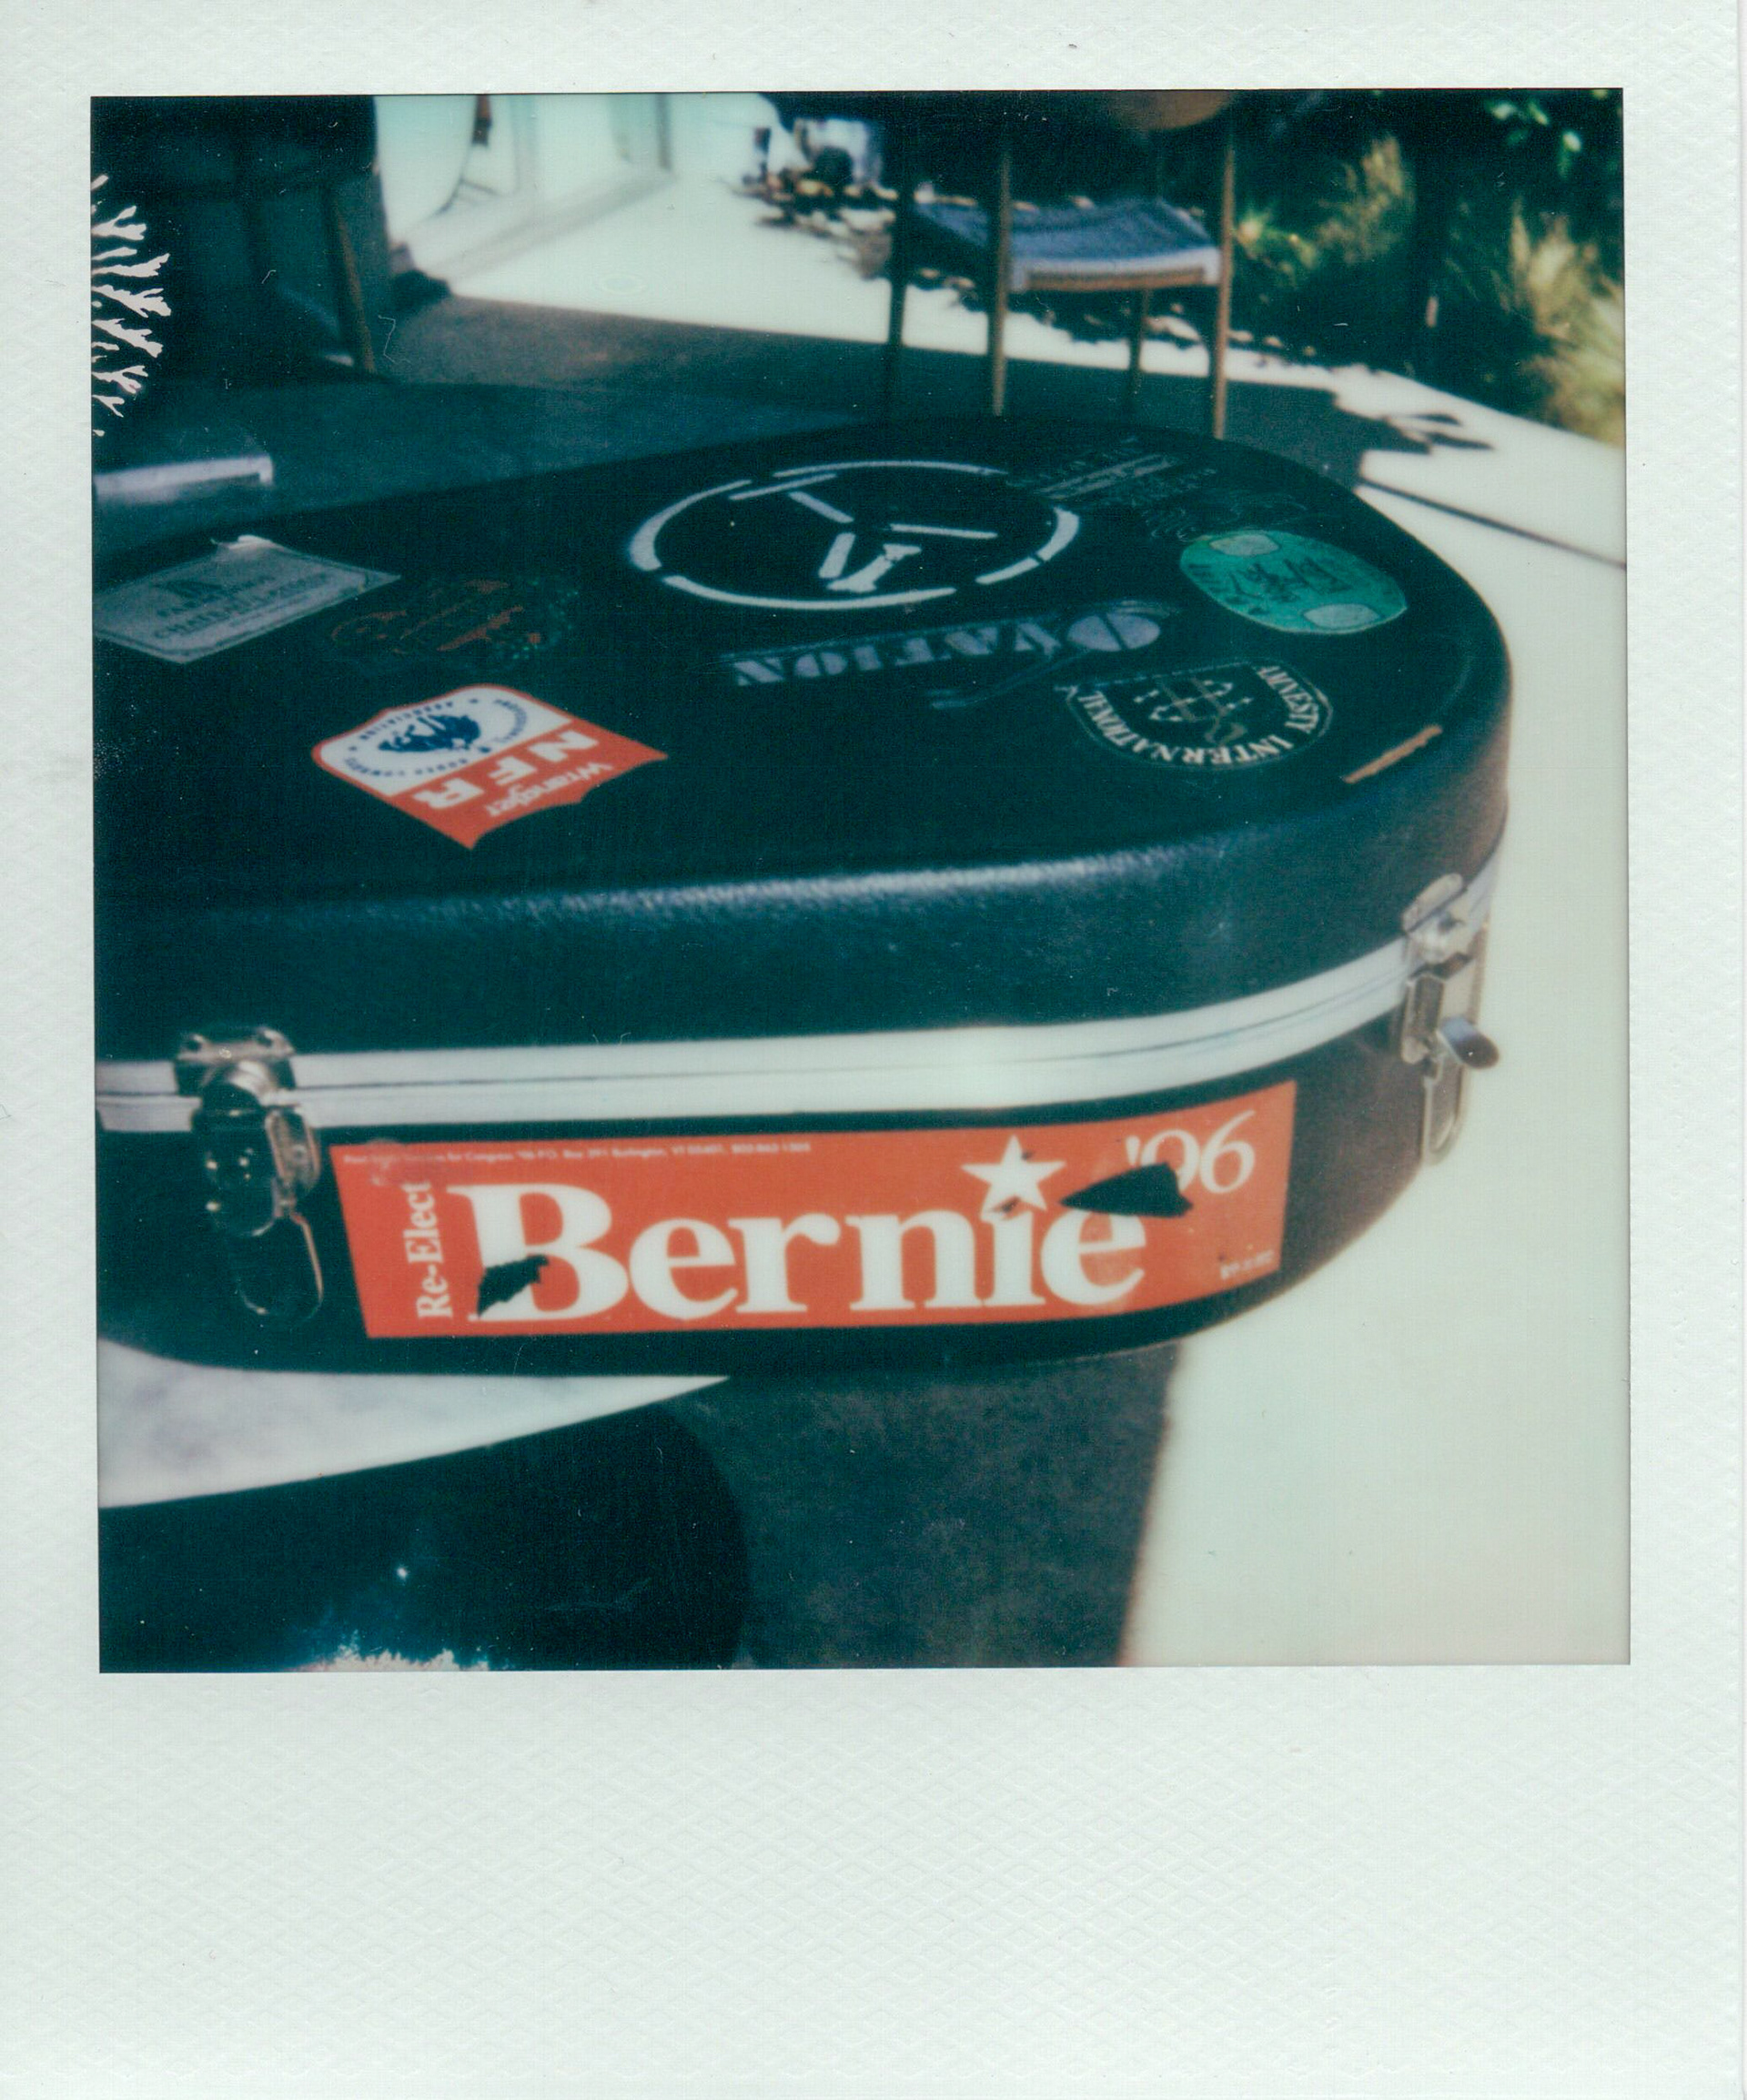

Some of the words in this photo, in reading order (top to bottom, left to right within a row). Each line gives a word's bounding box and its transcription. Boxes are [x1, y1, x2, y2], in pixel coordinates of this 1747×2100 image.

[734, 611, 1160, 686] OVATION
[412, 729, 599, 809] NFR
[1076, 690, 1294, 765] INTERNATIONAL
[1125, 1109, 1256, 1196] '96
[400, 1179, 453, 1319] Re-Elect
[446, 1181, 1146, 1322] Bernie
